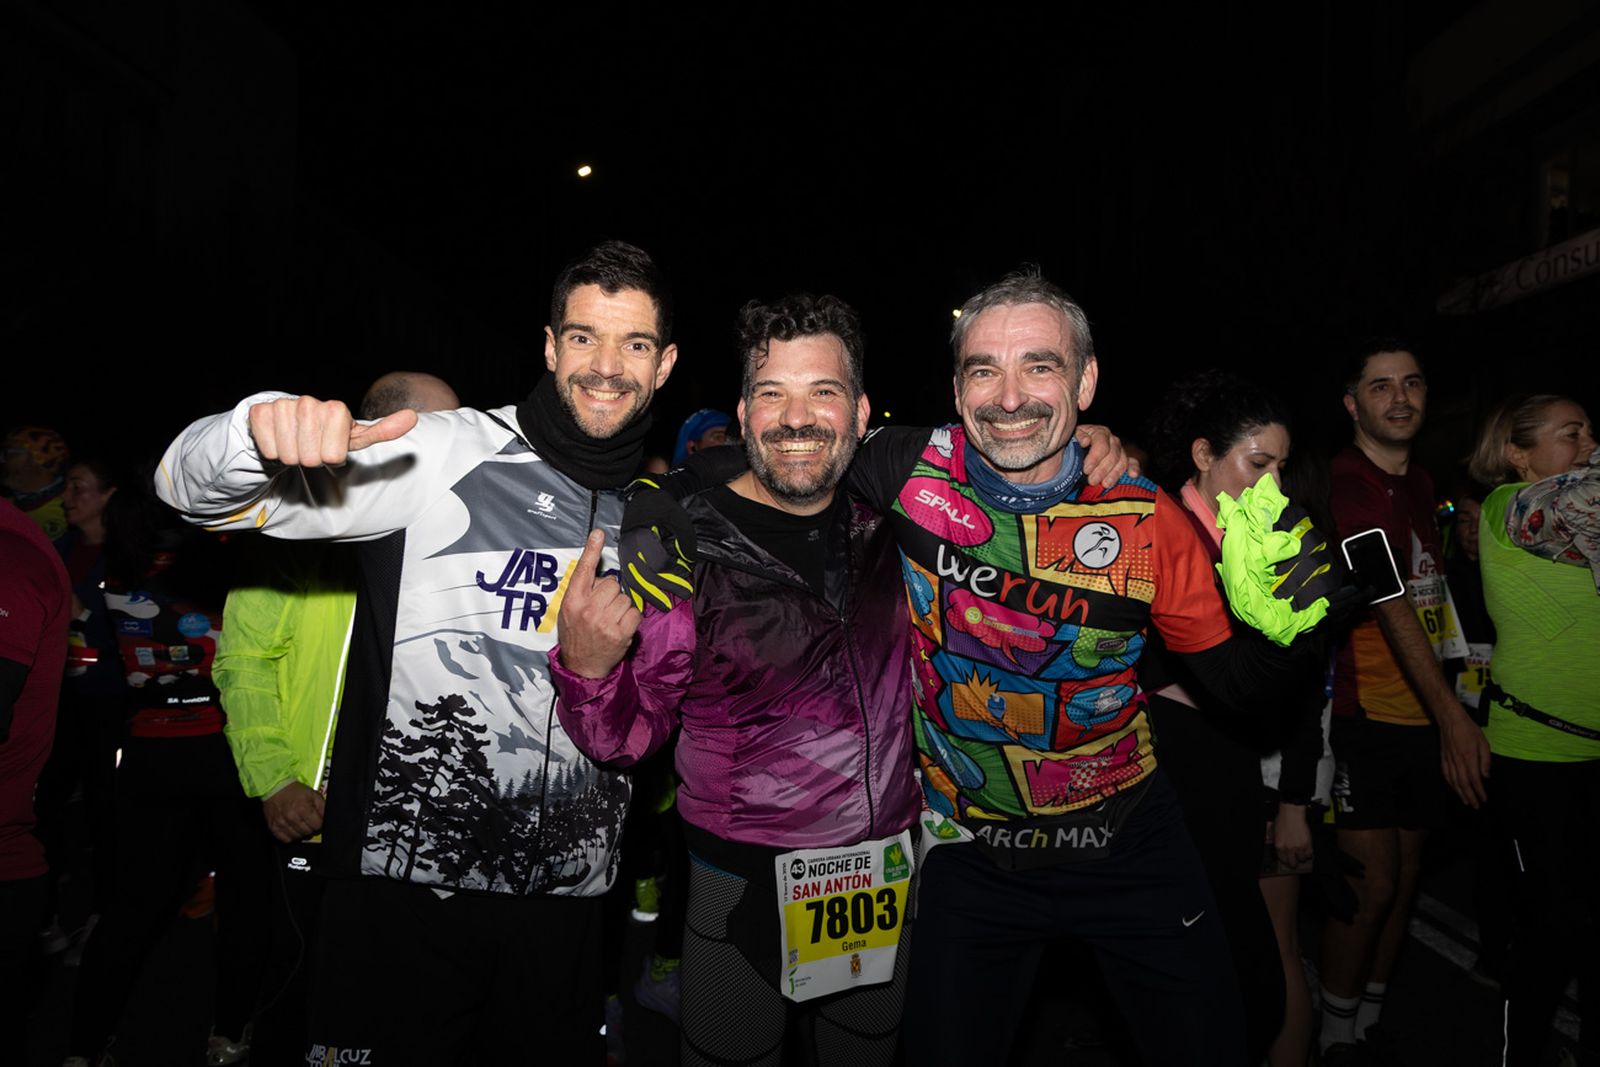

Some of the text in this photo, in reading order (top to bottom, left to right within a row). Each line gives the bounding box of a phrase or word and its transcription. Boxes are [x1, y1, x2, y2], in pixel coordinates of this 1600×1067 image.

[808, 859, 853, 879] NOCHE
[855, 856, 872, 871] DE
[792, 880, 821, 901] SAN
[824, 870, 872, 895] ANTÓN
[806, 888, 899, 945] 7803
[841, 939, 867, 952] Gema
